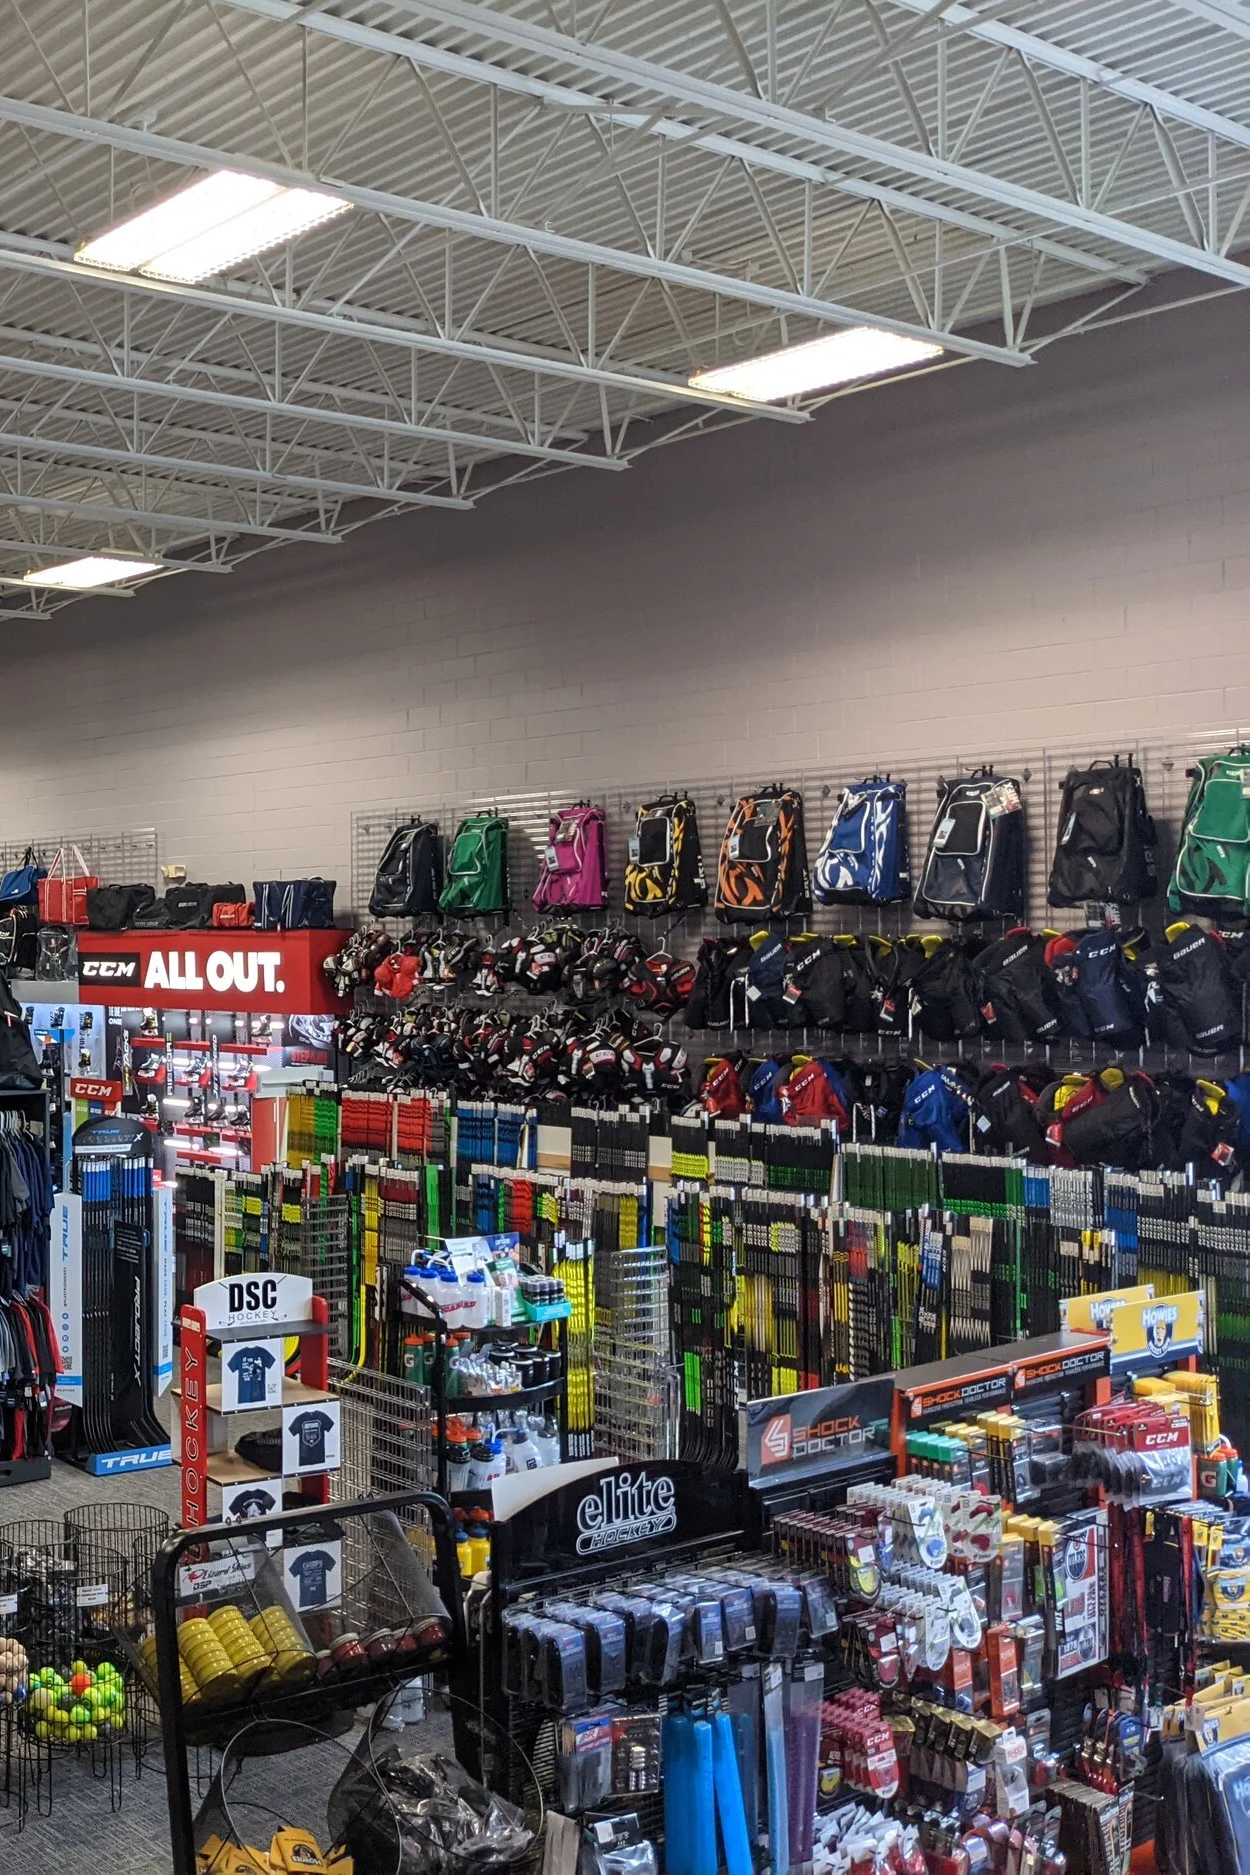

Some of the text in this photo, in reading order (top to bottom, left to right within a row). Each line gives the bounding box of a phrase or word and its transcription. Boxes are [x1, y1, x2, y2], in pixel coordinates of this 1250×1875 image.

[760, 943, 782, 963] BAUER
[1002, 944, 1028, 966] BAUER
[1088, 944, 1116, 959] CCM
[1172, 937, 1206, 960] BAUER
[796, 949, 821, 971] CCM
[82, 950, 285, 993] CCM ALL OUT.
[712, 1067, 730, 1086] CCM
[753, 1072, 772, 1090] CCM
[794, 1072, 815, 1091] CCM
[75, 1083, 112, 1096] CCM
[914, 1084, 935, 1104] CCM
[62, 1204, 70, 1262] TRUE
[228, 1279, 278, 1313] DSC
[228, 1310, 278, 1323] HOCKEY
[1142, 1306, 1178, 1325] HOWIES
[405, 1353, 415, 1369] G
[1026, 1351, 1104, 1380] SHOCK DOCTOR
[134, 1363, 142, 1388] X
[921, 1377, 1006, 1408] SHOCK DOCTOR
[185, 1347, 199, 1526] HOCKEY
[793, 1416, 860, 1442] SHOCK
[1145, 1432, 1178, 1445] CCM
[793, 1425, 877, 1459] DOCTOR
[101, 1449, 171, 1469] TRUE
[1201, 1471, 1217, 1488] G
[577, 1471, 675, 1533] elite
[590, 1518, 666, 1549] HOCKEY
[203, 1564, 230, 1580] Lizard
[193, 1581, 212, 1591] DSP
[866, 1731, 890, 1746] CCM
